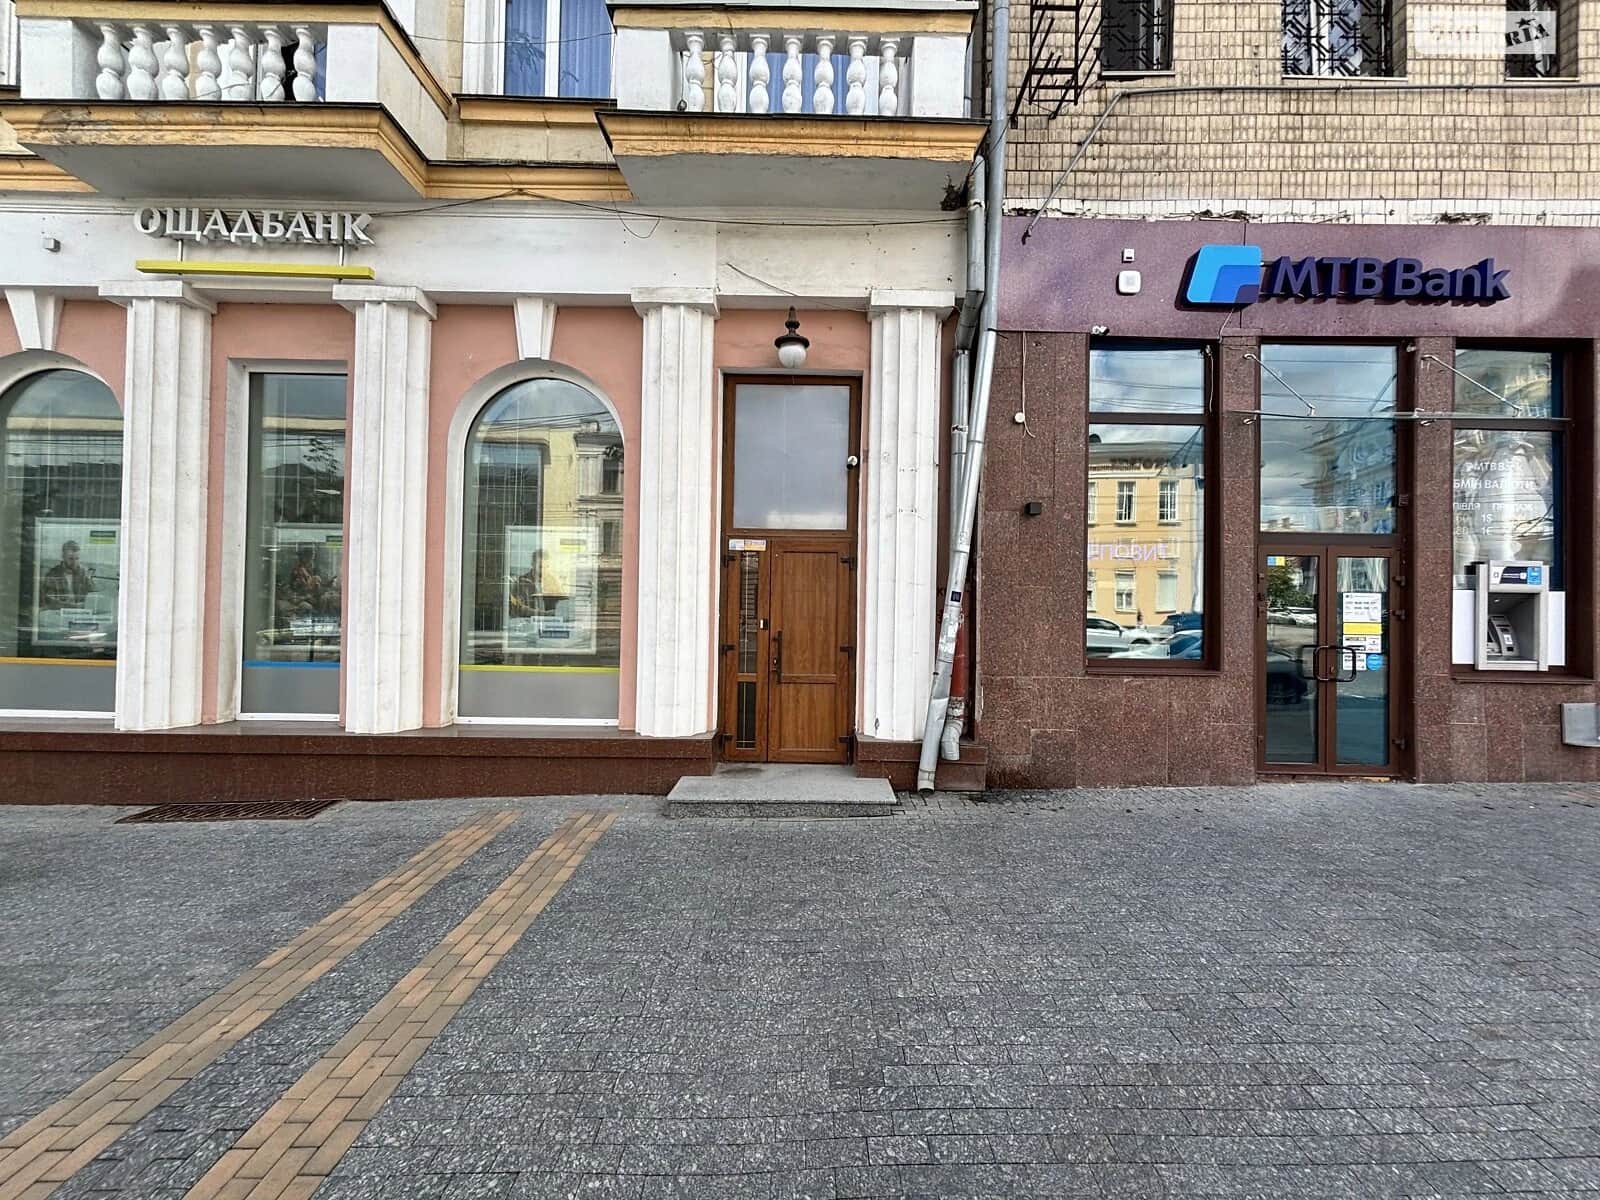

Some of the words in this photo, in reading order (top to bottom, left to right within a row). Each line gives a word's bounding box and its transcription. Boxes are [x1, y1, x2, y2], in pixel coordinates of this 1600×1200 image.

[133, 207, 376, 245] ОЩАДБАНК
[1272, 255, 1385, 297] MTB
[1393, 257, 1512, 299] Bank
